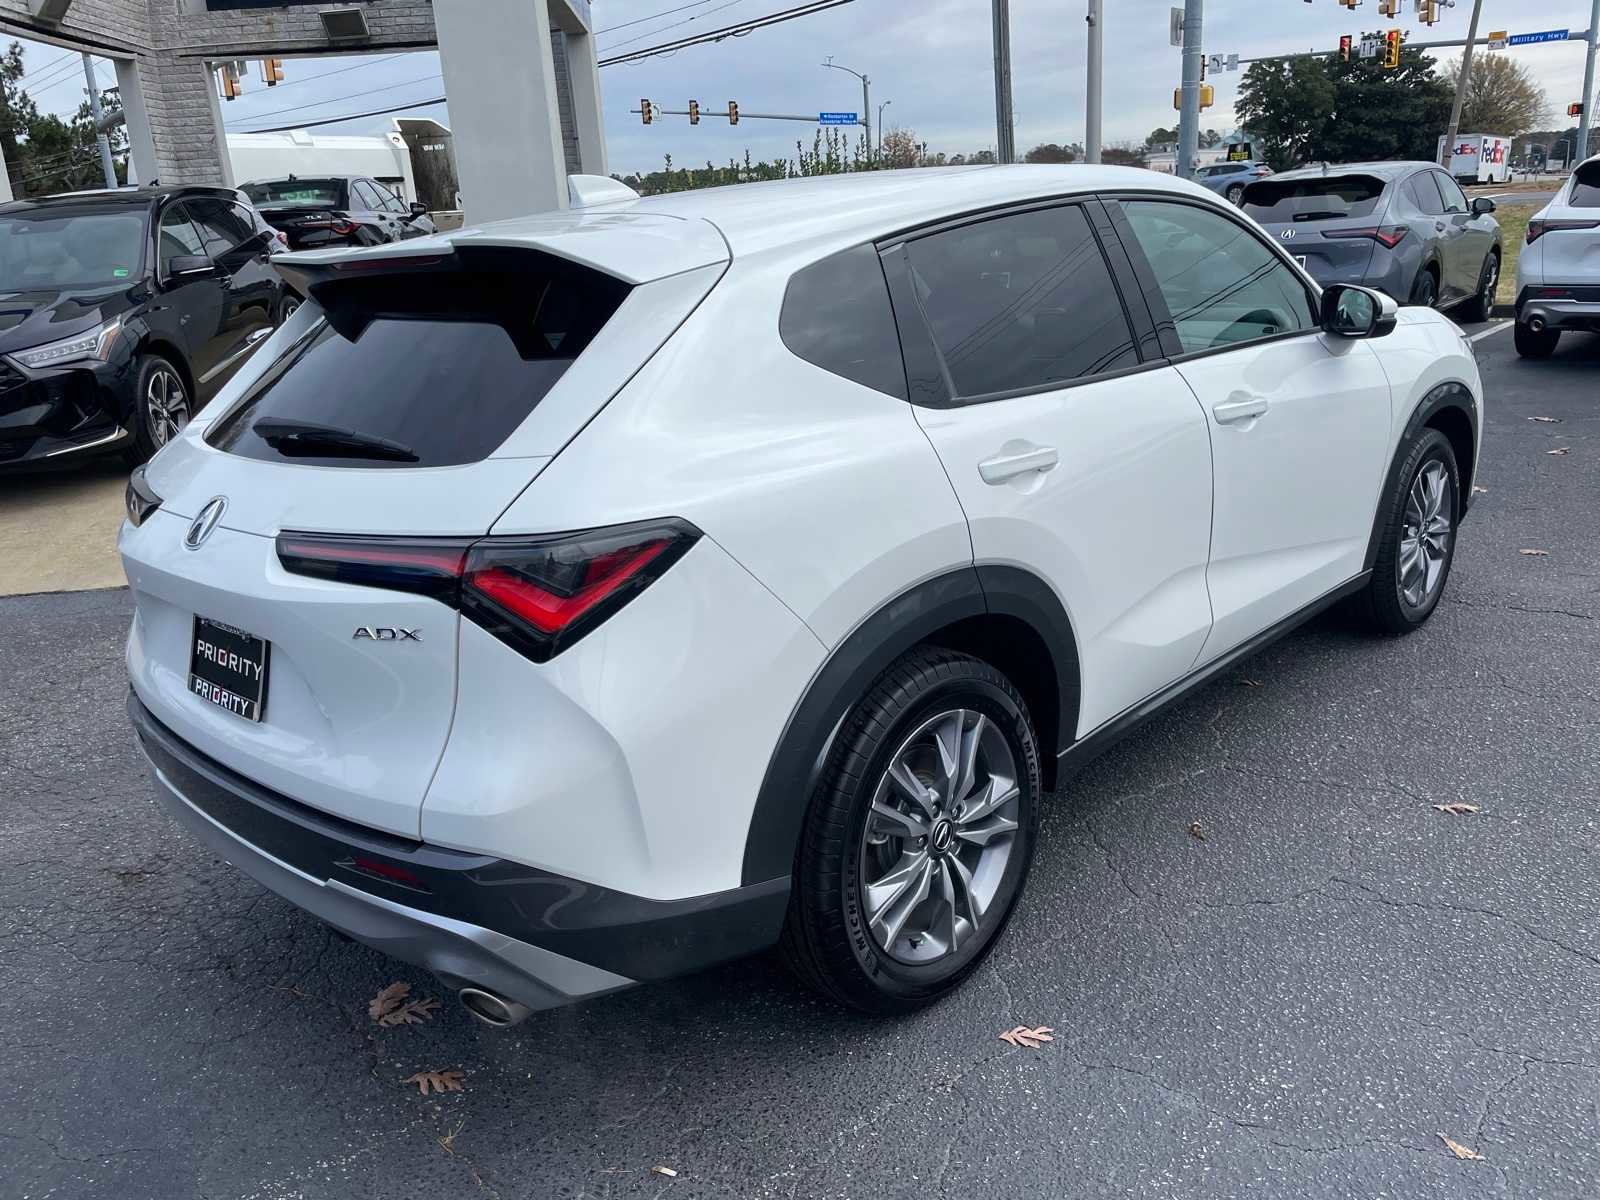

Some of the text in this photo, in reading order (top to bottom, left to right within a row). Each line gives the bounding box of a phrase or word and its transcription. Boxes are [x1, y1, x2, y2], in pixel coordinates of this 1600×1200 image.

[1481, 138, 1505, 164] FedEx
[351, 626, 424, 641] ADX
[196, 639, 262, 681] PRIORITY
[195, 678, 249, 716] PRIORITY
